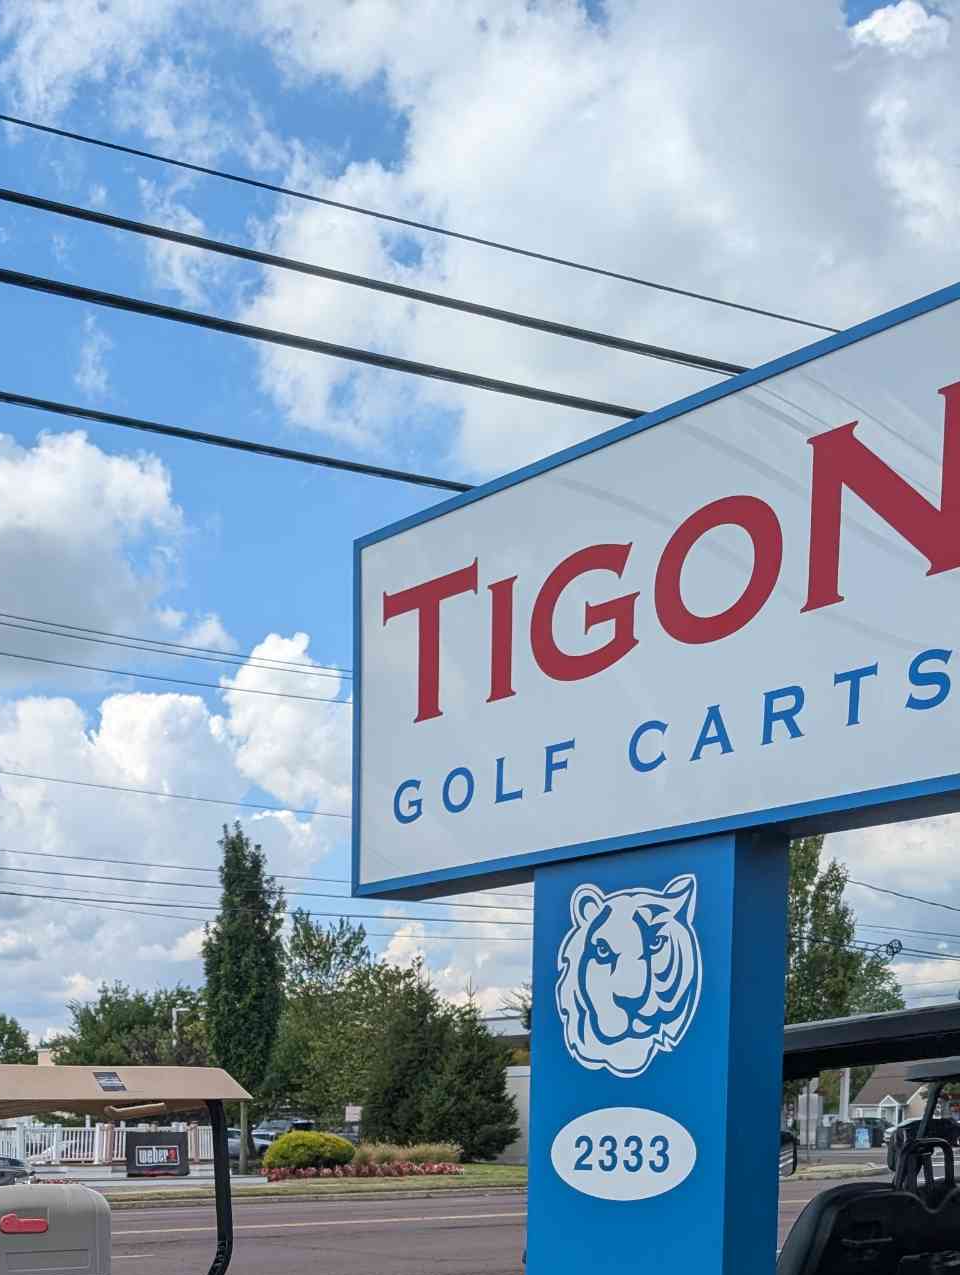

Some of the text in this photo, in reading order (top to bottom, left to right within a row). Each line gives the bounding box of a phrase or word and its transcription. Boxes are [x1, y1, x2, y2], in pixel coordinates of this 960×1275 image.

[383, 380, 960, 723] TIGON
[393, 648, 953, 824] GOLF CARTS
[574, 1135, 670, 1173] 2333
